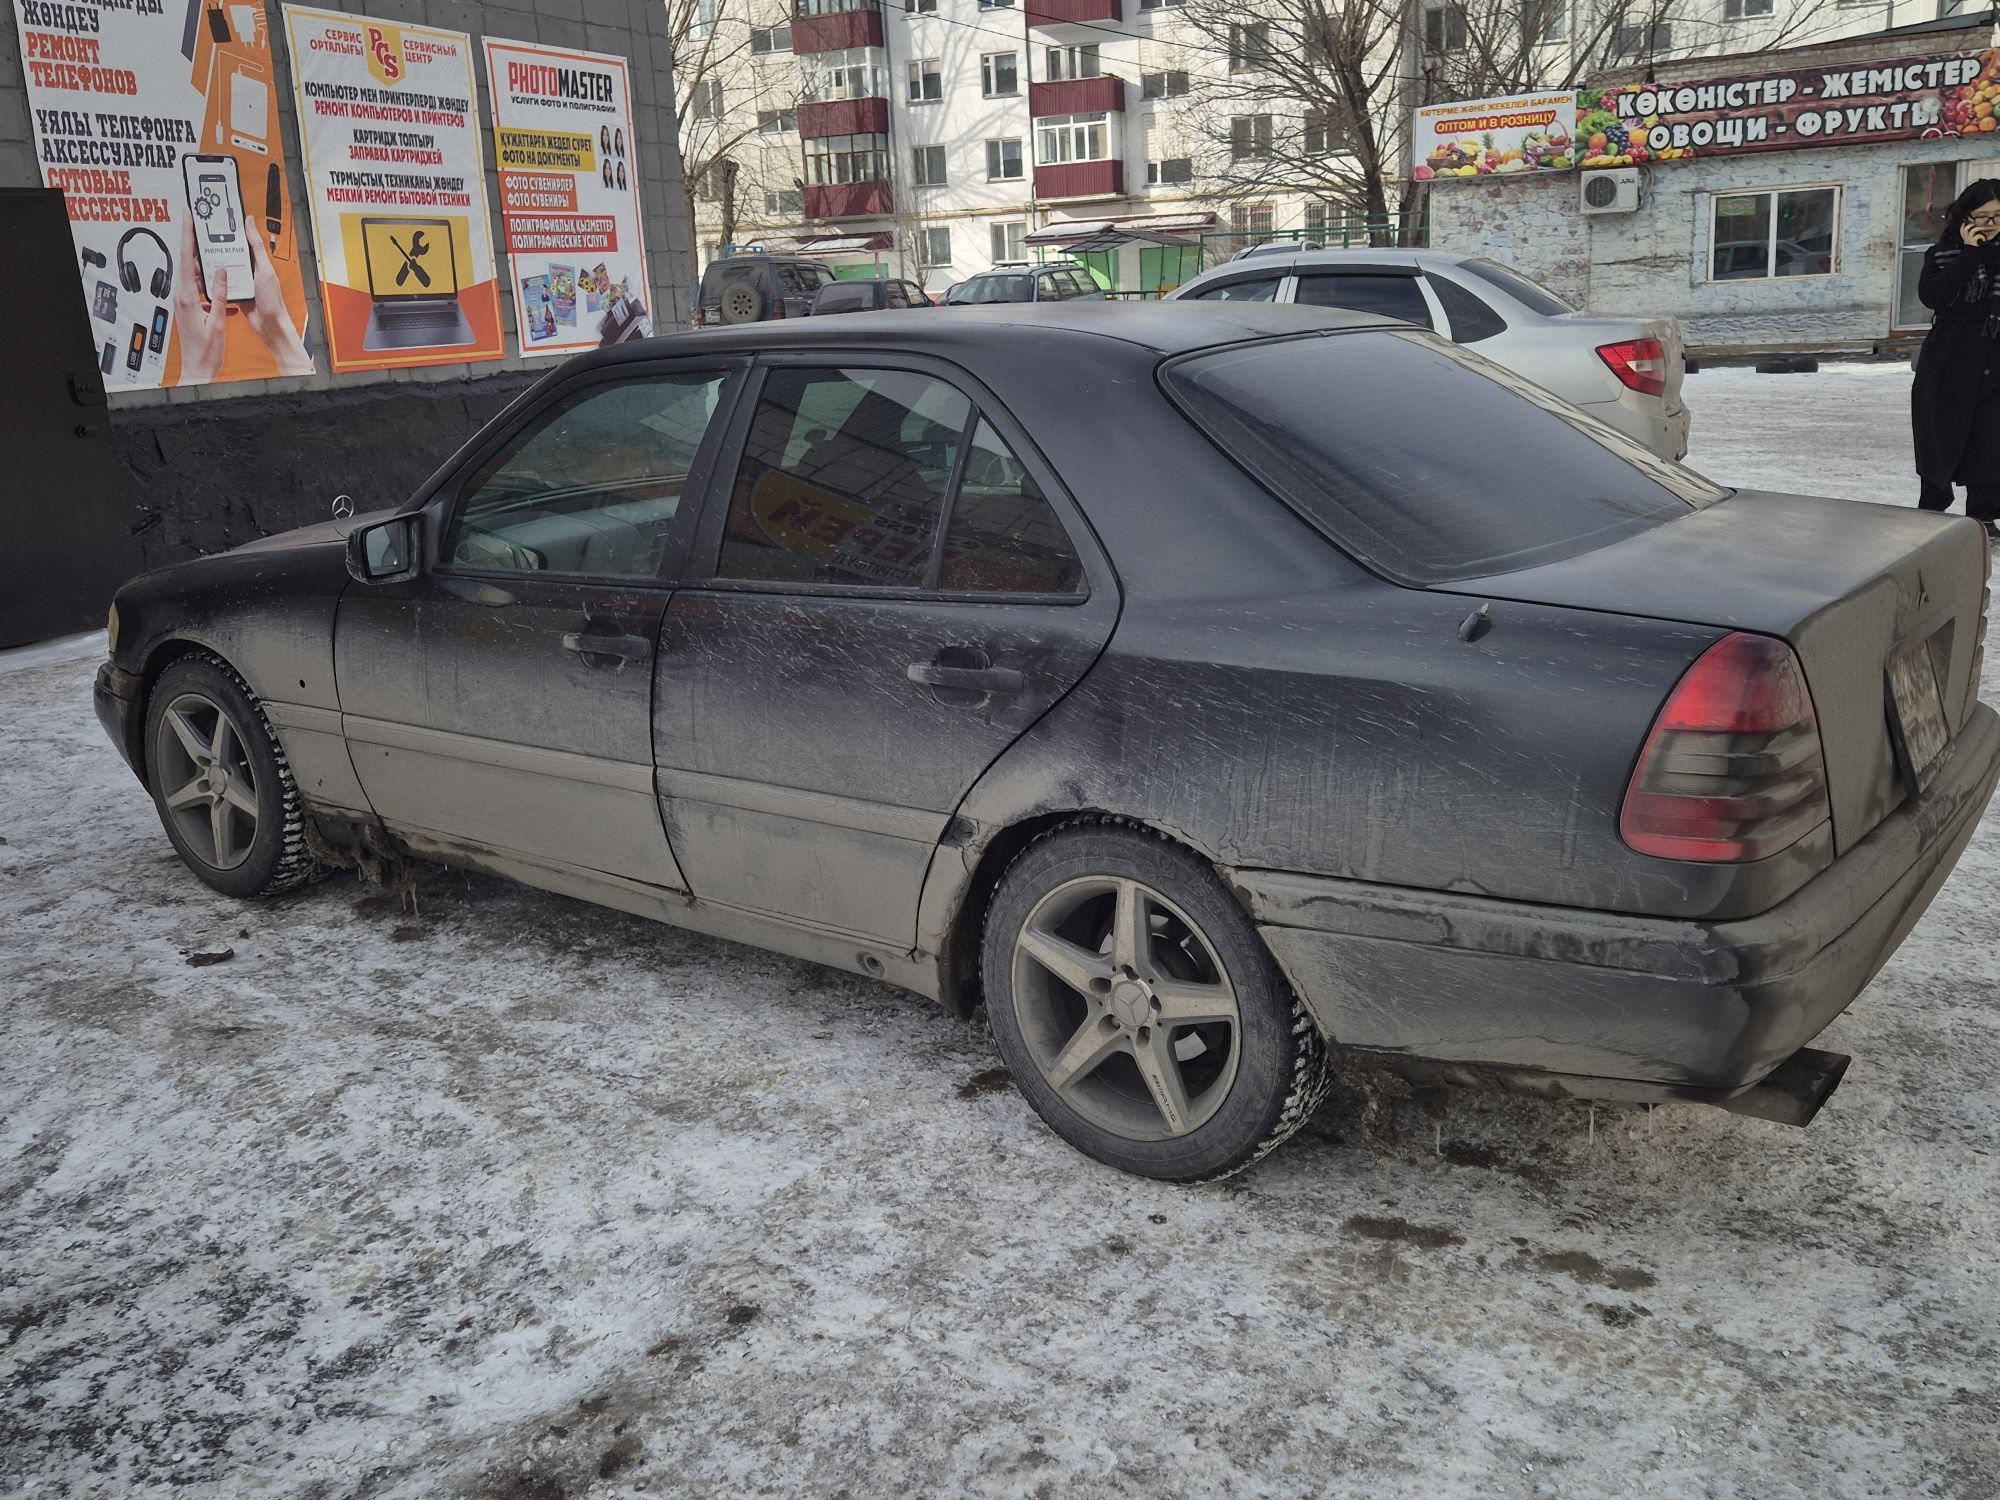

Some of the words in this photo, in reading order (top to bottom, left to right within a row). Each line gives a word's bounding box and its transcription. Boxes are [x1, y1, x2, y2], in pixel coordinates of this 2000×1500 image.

[21, 0, 100, 35] ЖӨНДЕУ
[325, 28, 362, 43] СЕРВИС
[25, 31, 100, 64] РЕМОНТ
[310, 39, 364, 56] ОРТАЛЫҒЫ
[403, 39, 457, 57] СЕРВИСНЫЙ
[405, 52, 433, 64] ЦЕНТР
[29, 61, 138, 96] ТЕЛЕФОНОВ
[508, 61, 613, 103] PHOTOMASTER
[1617, 78, 1798, 120] КӨКӨНІСТЕР
[1821, 58, 1982, 100] ЖЕМІСТЕР
[305, 81, 359, 101] КОМПЬЮТЕР
[360, 87, 378, 103] МЕН
[379, 90, 436, 111] ПРИНТЕРЛЕРДІ
[437, 96, 469, 113] ЖӨНДЕУ
[510, 96, 539, 106] УСЛУГИ
[540, 98, 562, 108] ФОТО
[563, 101, 568, 109] И
[569, 102, 617, 113] ПОЛИГРАФИИ
[1420, 106, 1459, 117] КӨТЕРМЕ
[1460, 104, 1486, 115] ЖӘНЕ
[1487, 100, 1528, 111] ЖЕКЕЛЕЙ
[1530, 95, 1573, 107] БАҒАМЕН
[315, 100, 349, 117] РЕМОНТ
[351, 103, 413, 123] КОМПЬЮТЕРОВ
[414, 109, 421, 123] И
[422, 110, 465, 128] ПРИНТЕРОВ
[1436, 120, 1477, 133] ОПТОМ
[1478, 118, 1488, 129] И
[1489, 117, 1498, 128] В
[1500, 111, 1555, 127] РОЗНИЦУ
[36, 109, 93, 137] ҰЯЛЫ
[95, 113, 197, 143] ТЕЛЕФОНҒА
[1648, 116, 1768, 151] ОВОЩИ
[1795, 101, 1940, 137] ФРУКТЫ
[353, 128, 397, 147] КАРТРИДЖ
[398, 132, 435, 149] ТОЛТЫРУ
[547, 136, 571, 152] ЖЕДЕЛ
[572, 138, 592, 152] СУРЕТ
[42, 138, 177, 168] АКСЕССУАРЛАР
[349, 145, 390, 161] ЗАПРАВКА
[391, 149, 443, 166] КАРТРИДЖЕЙ
[502, 149, 526, 164] ФОТО
[527, 150, 536, 165] НА
[537, 151, 581, 167] ДОКУМЕНТЫ
[47, 167, 132, 195] СОТОВЫЕ
[329, 171, 385, 189] ТҰРМЫСТЫҚ
[385, 174, 433, 190] ТЕХНИКАНЫ
[433, 176, 464, 192] ЖӨНДЕУ
[505, 175, 528, 190] ФОТО
[529, 176, 574, 192] СУВЕНИРЛЕР
[364, 189, 397, 204] РЕМОНТ
[399, 190, 438, 205] БЫТОВОЙ
[438, 192, 471, 207] ТЕХНИКИ
[507, 192, 530, 207] ФОТО
[531, 193, 569, 208] СУВЕНИРЫ
[510, 218, 576, 233] ПОЛИГРАФИЯЛЫҚ
[576, 219, 614, 234] ҚЫЗМЕТТЕР
[512, 234, 582, 249] ПОЛИГРАФИЧЕСКИЕ
[582, 235, 608, 248] УСЛУГИ
